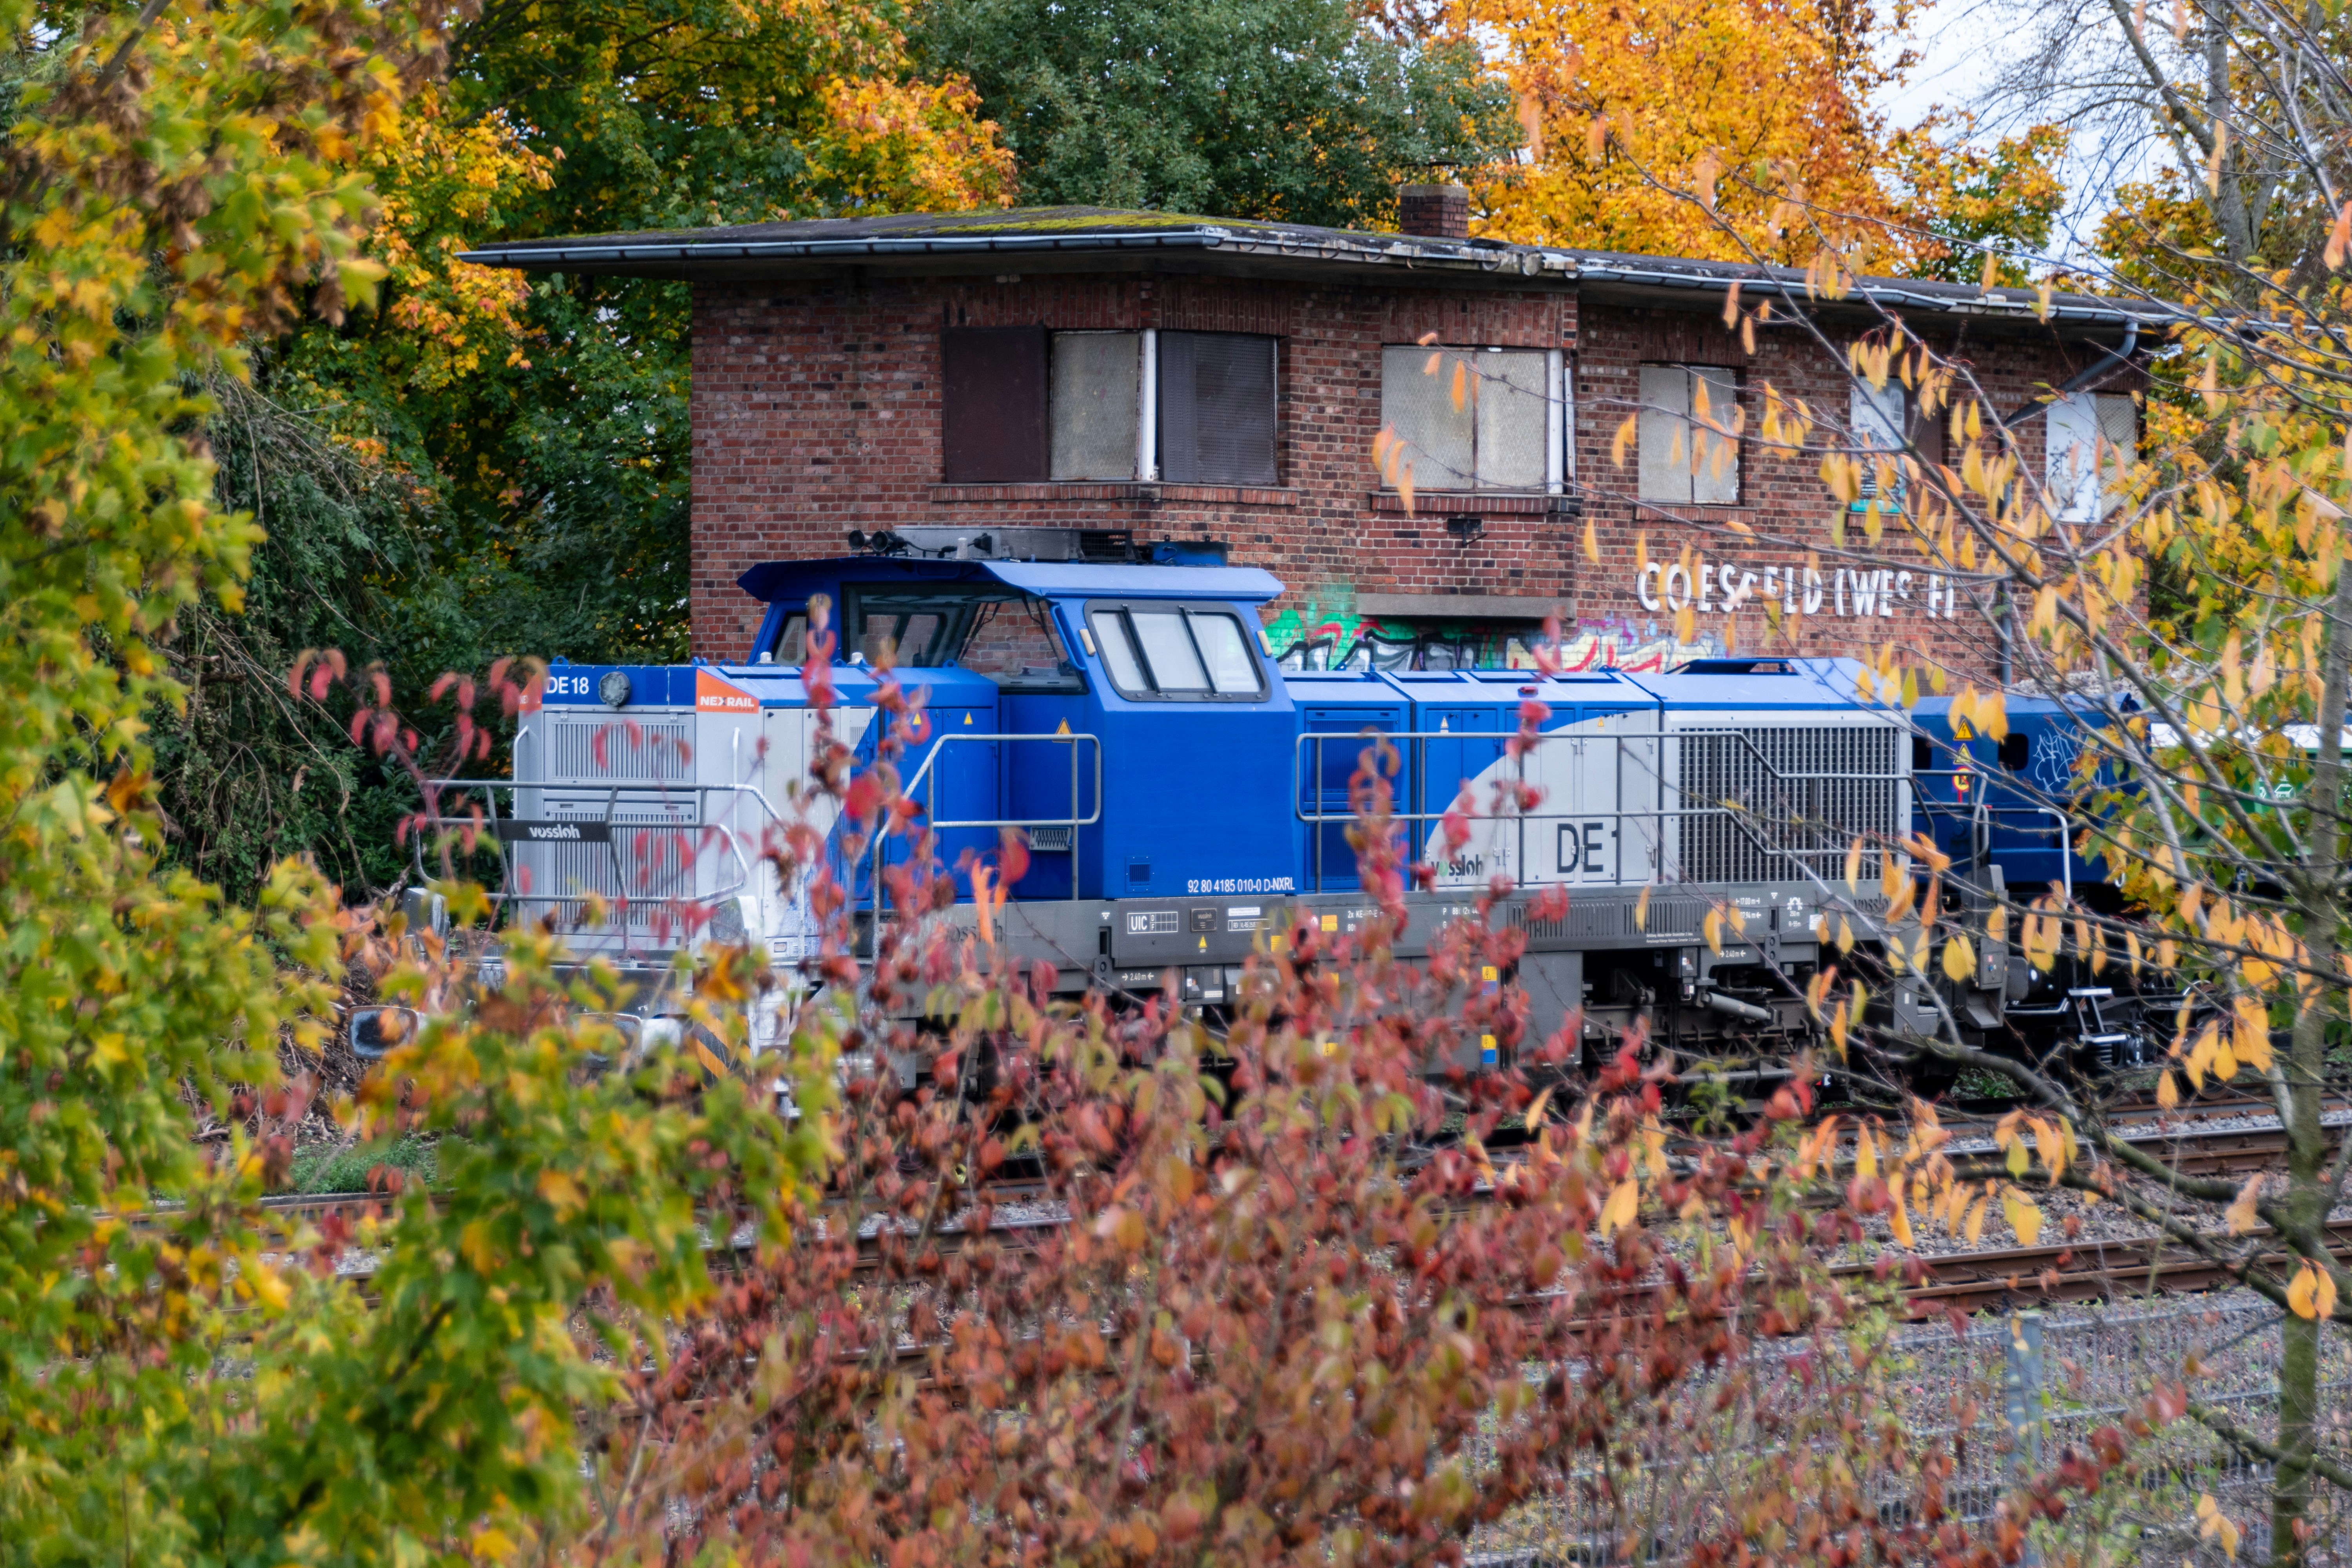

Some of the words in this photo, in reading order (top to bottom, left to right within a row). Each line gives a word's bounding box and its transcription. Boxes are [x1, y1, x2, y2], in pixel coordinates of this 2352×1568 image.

[546, 677, 568, 693] DE
[571, 677, 589, 694] 18
[700, 696, 754, 707] NEXRAIL
[529, 824, 581, 838] vossloh
[1557, 822, 1603, 873] DE
[1188, 880, 1198, 893] 92
[1201, 879, 1212, 892] 80
[1214, 879, 1235, 892] 4185
[1237, 879, 1261, 891] 010-0
[1264, 877, 1295, 891] D-NXRL
[1131, 916, 1147, 931] UIC
